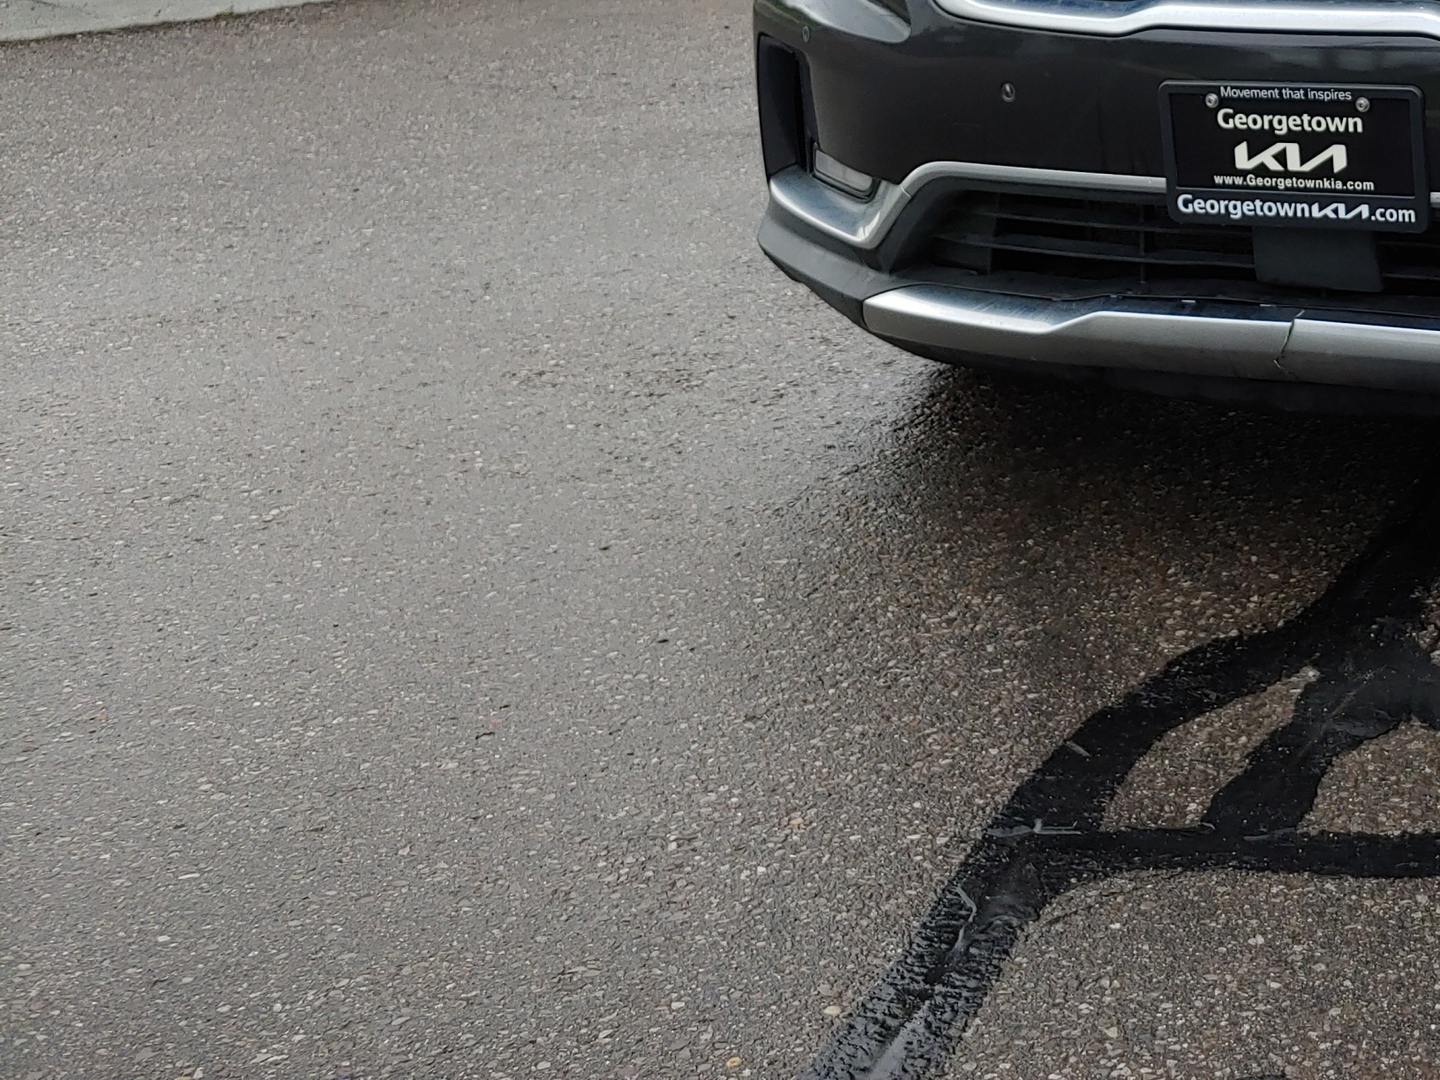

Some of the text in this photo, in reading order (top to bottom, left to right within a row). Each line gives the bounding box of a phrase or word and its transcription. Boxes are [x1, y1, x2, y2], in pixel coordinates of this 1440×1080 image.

[1220, 86, 1352, 102] Movement that inspires
[1217, 108, 1363, 135] Georgetown
[1234, 140, 1348, 173] KIA
[1214, 174, 1375, 191] www.Georgetownkia.com
